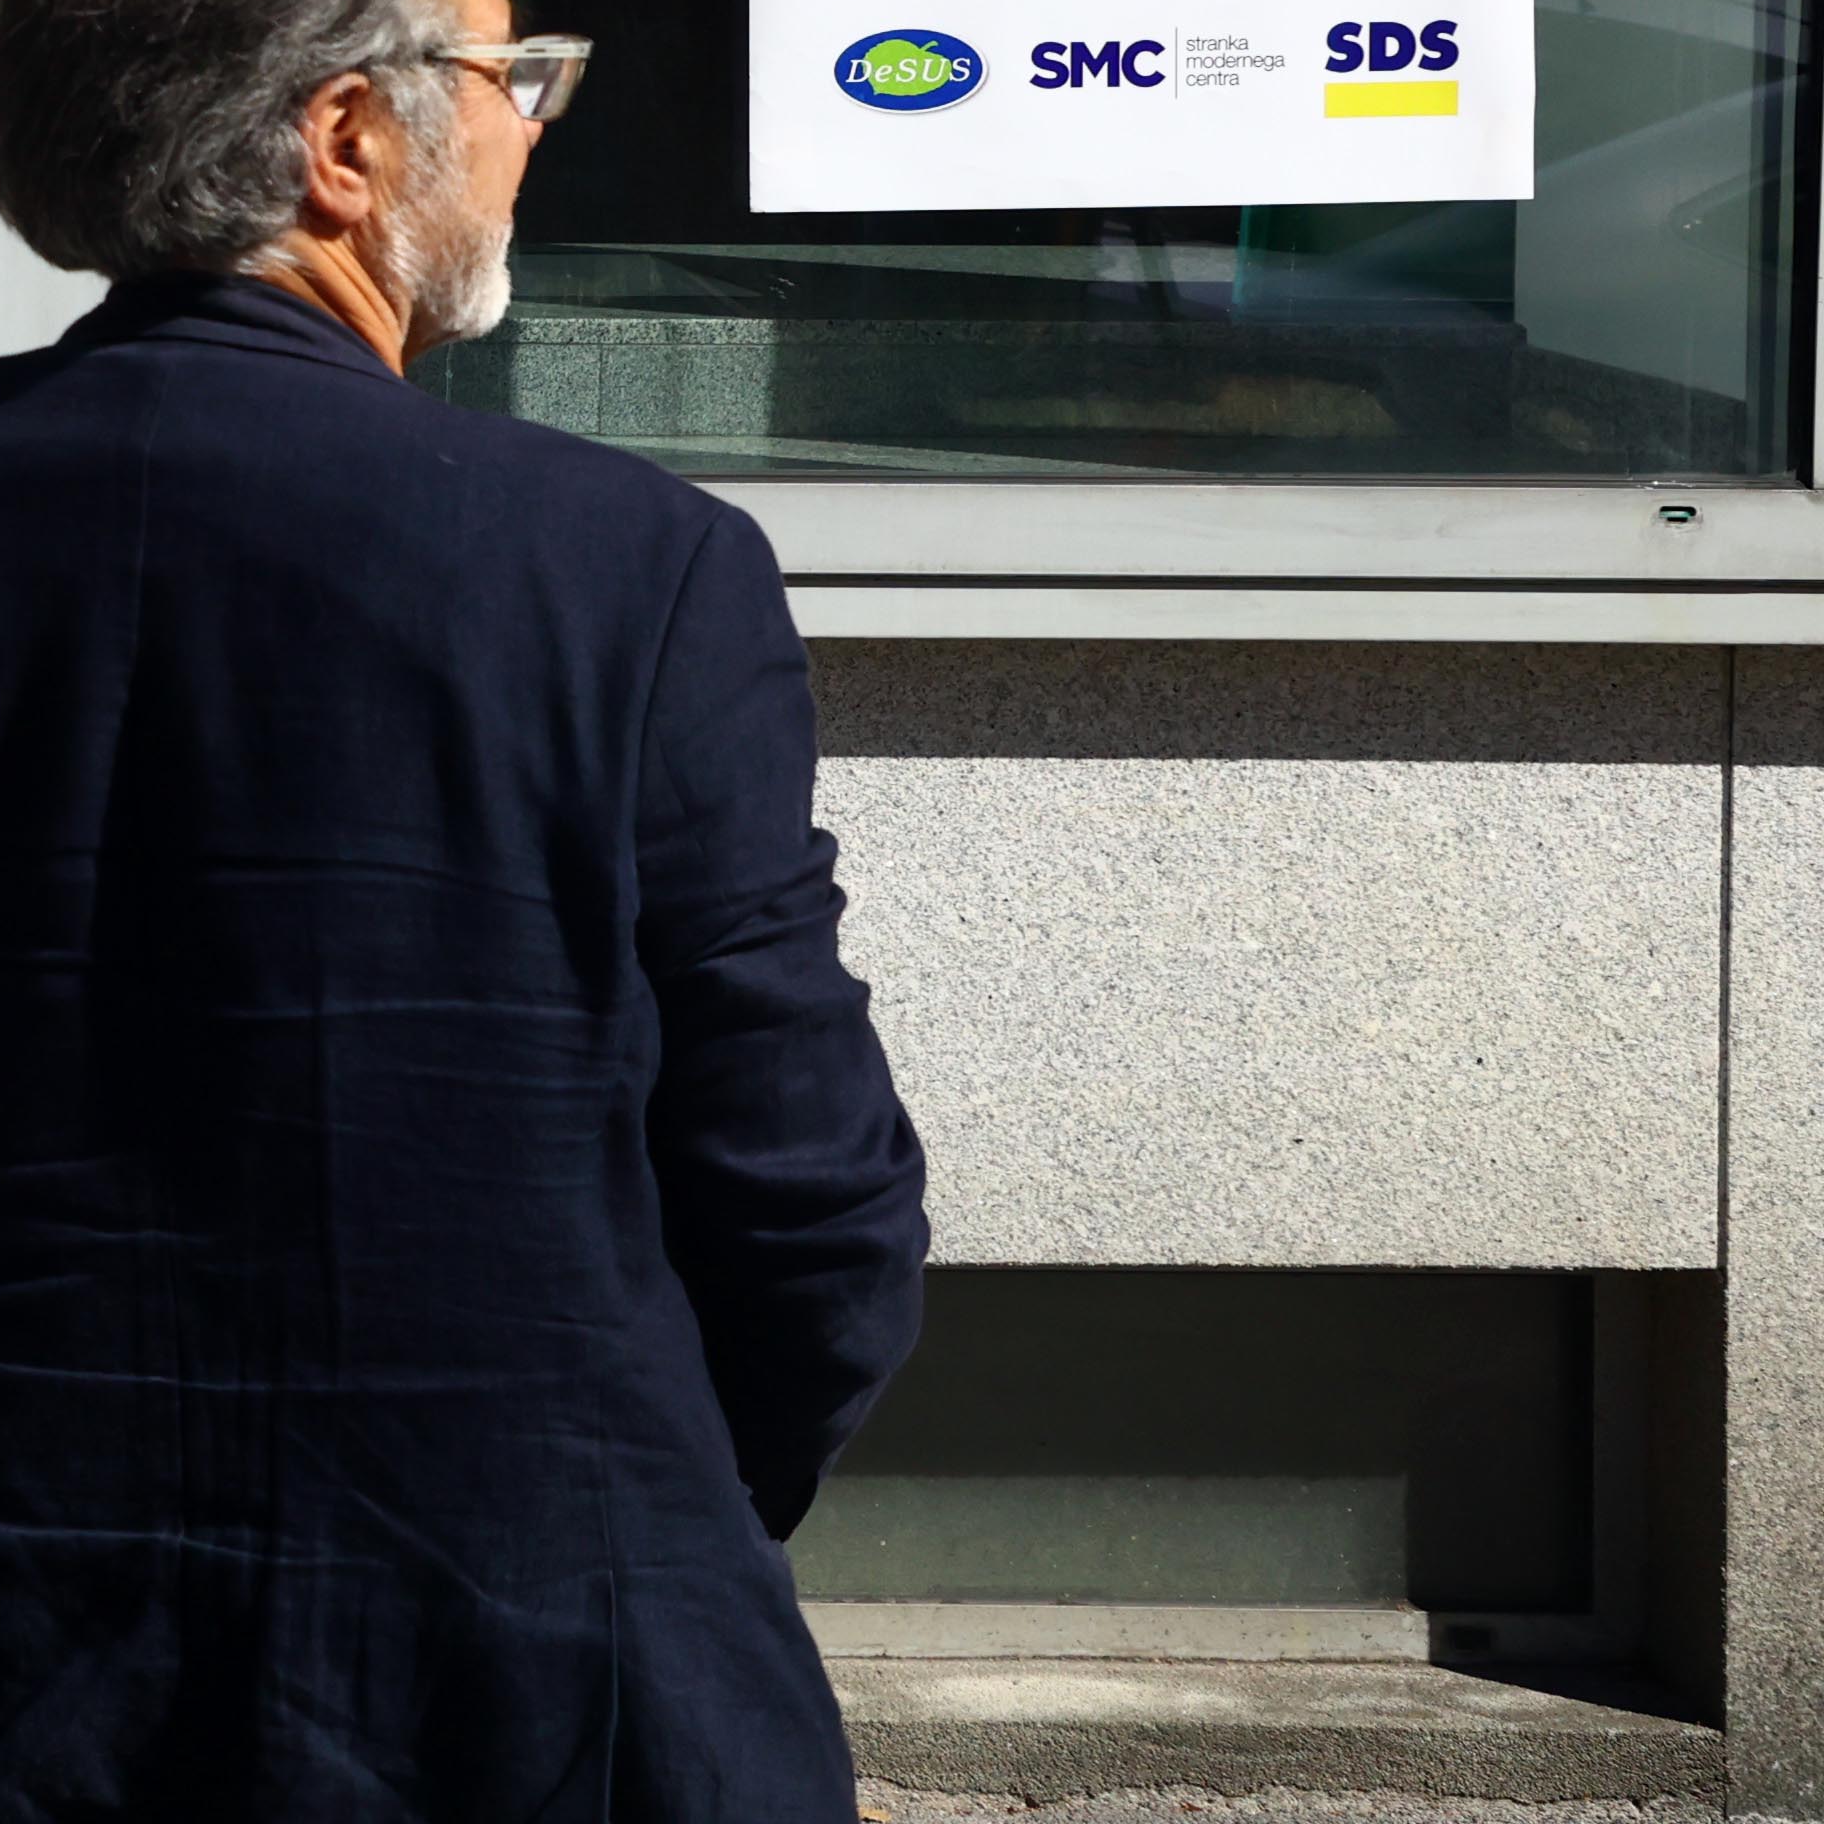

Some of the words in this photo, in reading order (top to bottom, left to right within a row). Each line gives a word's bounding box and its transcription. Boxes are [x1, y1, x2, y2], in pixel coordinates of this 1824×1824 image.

[1186, 35, 1249, 52] stranka
[1324, 19, 1460, 74] SDS
[846, 55, 970, 83] DeSUS
[1028, 39, 1167, 90] SMC
[1186, 53, 1285, 72] modernega
[1186, 71, 1240, 87] centra
